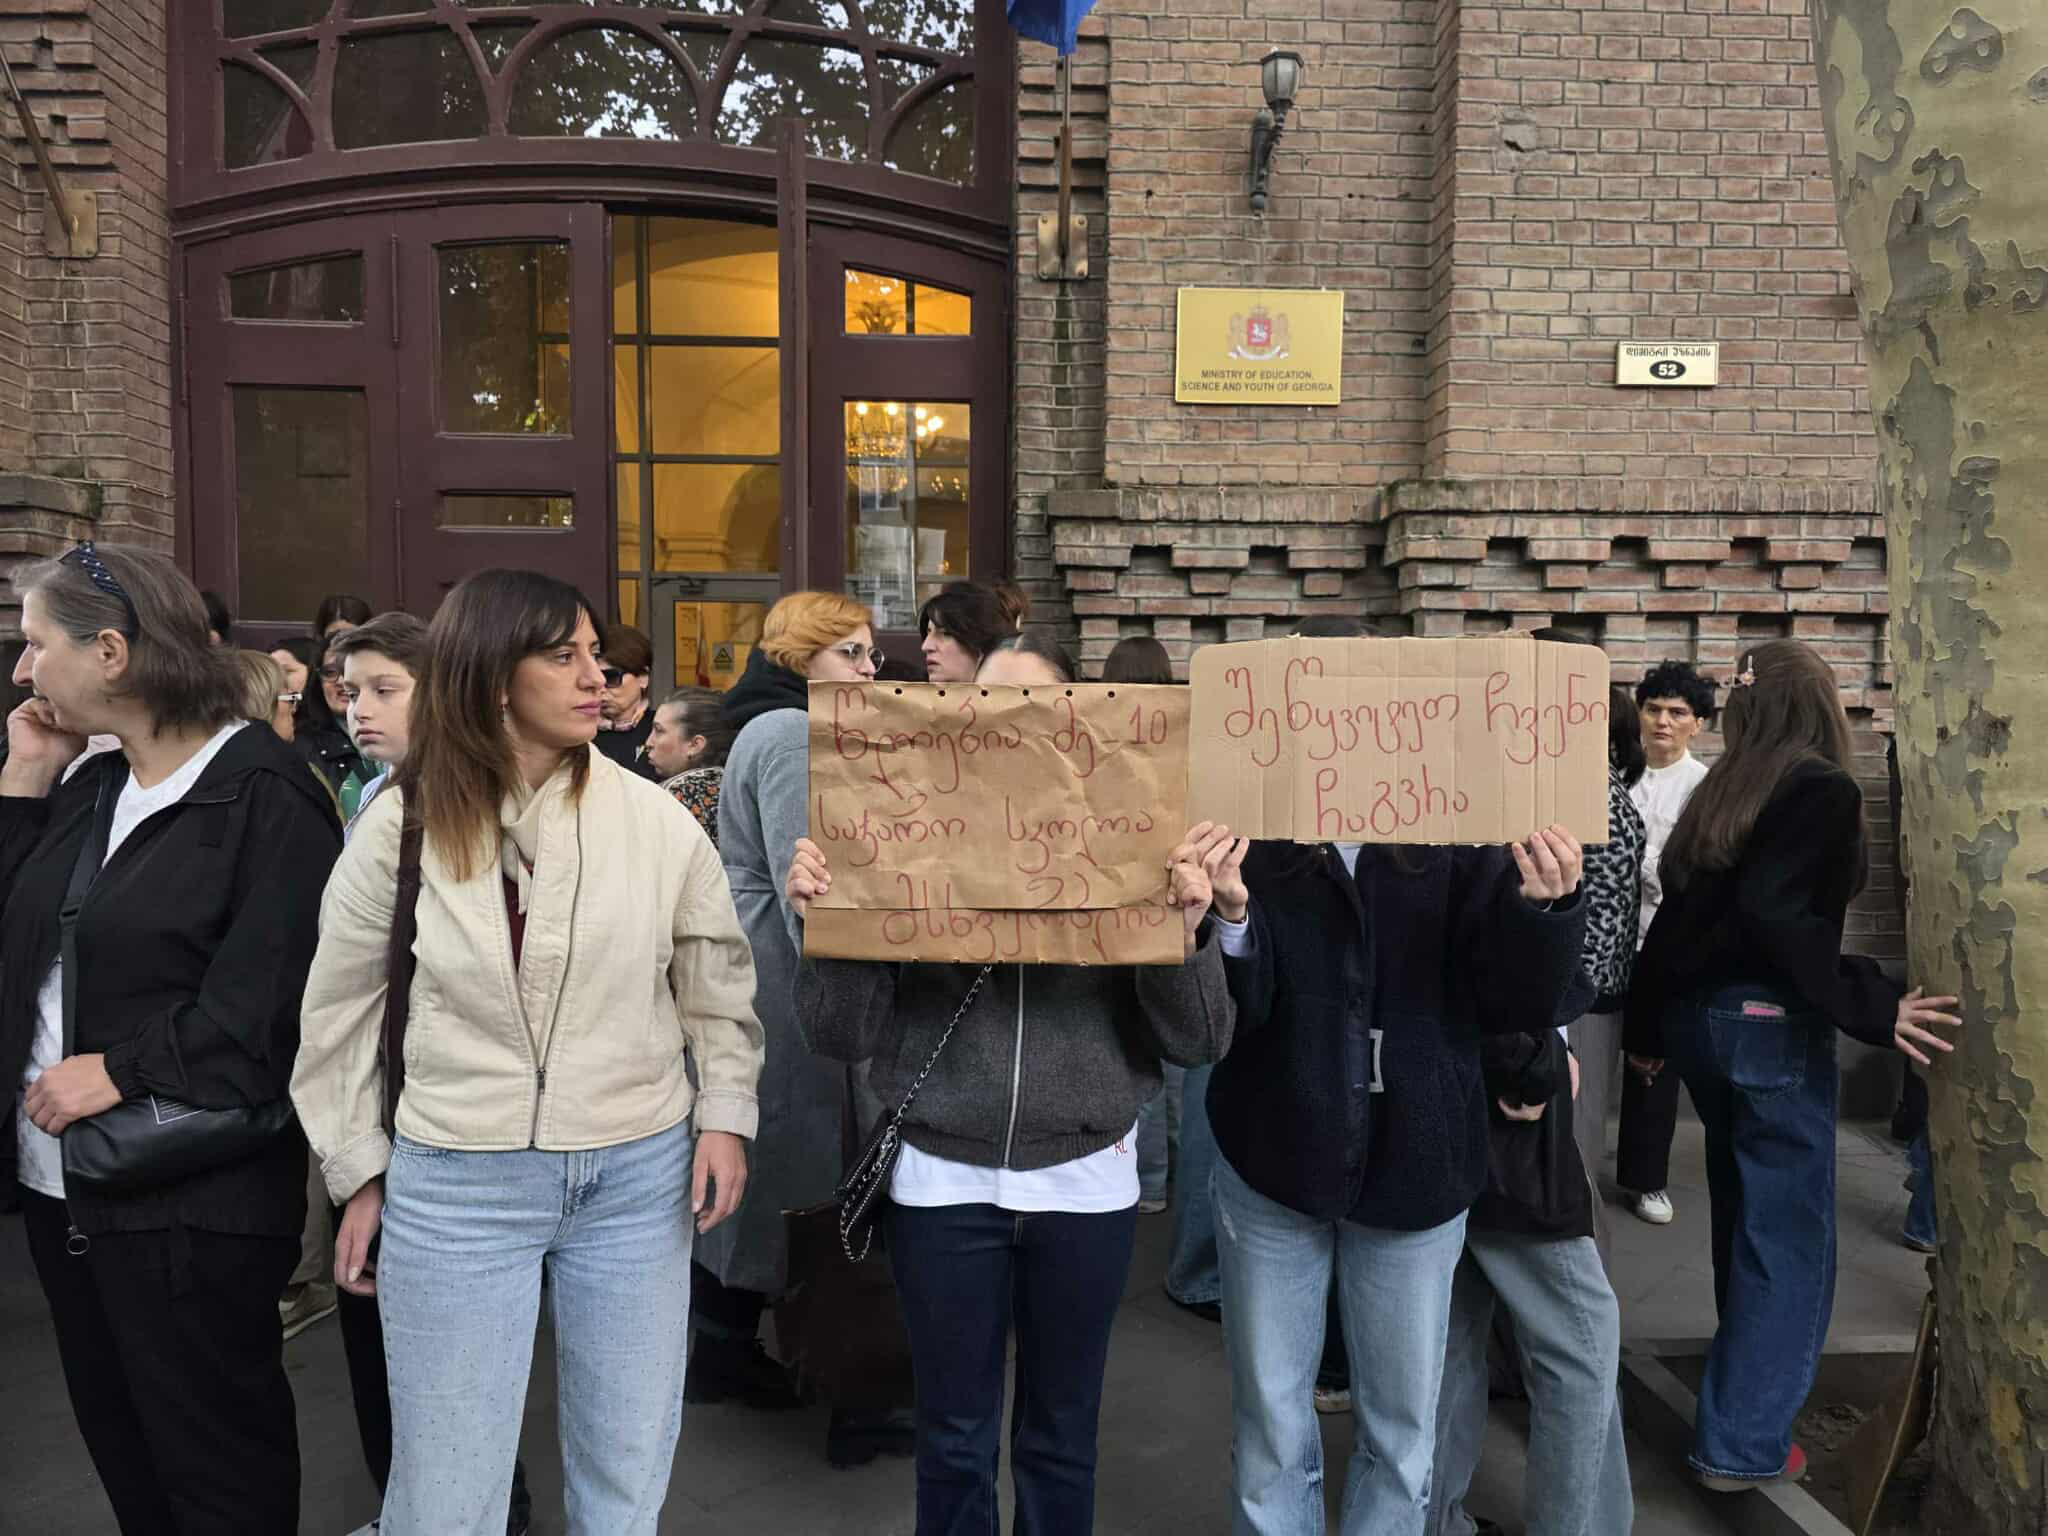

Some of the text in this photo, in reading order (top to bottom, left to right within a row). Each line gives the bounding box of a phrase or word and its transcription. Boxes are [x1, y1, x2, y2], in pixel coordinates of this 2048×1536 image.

[1201, 370, 1242, 379] MINISTRY
[1246, 370, 1257, 379] OF
[1658, 364, 1678, 376] 52
[1182, 381, 1333, 392] SCIENCE AND YOUTH OF GEORGIA
[1225, 656, 1608, 767] შეწყვიტეთ ჩვენი
[819, 793, 1154, 873] საჯარო სკოლა
